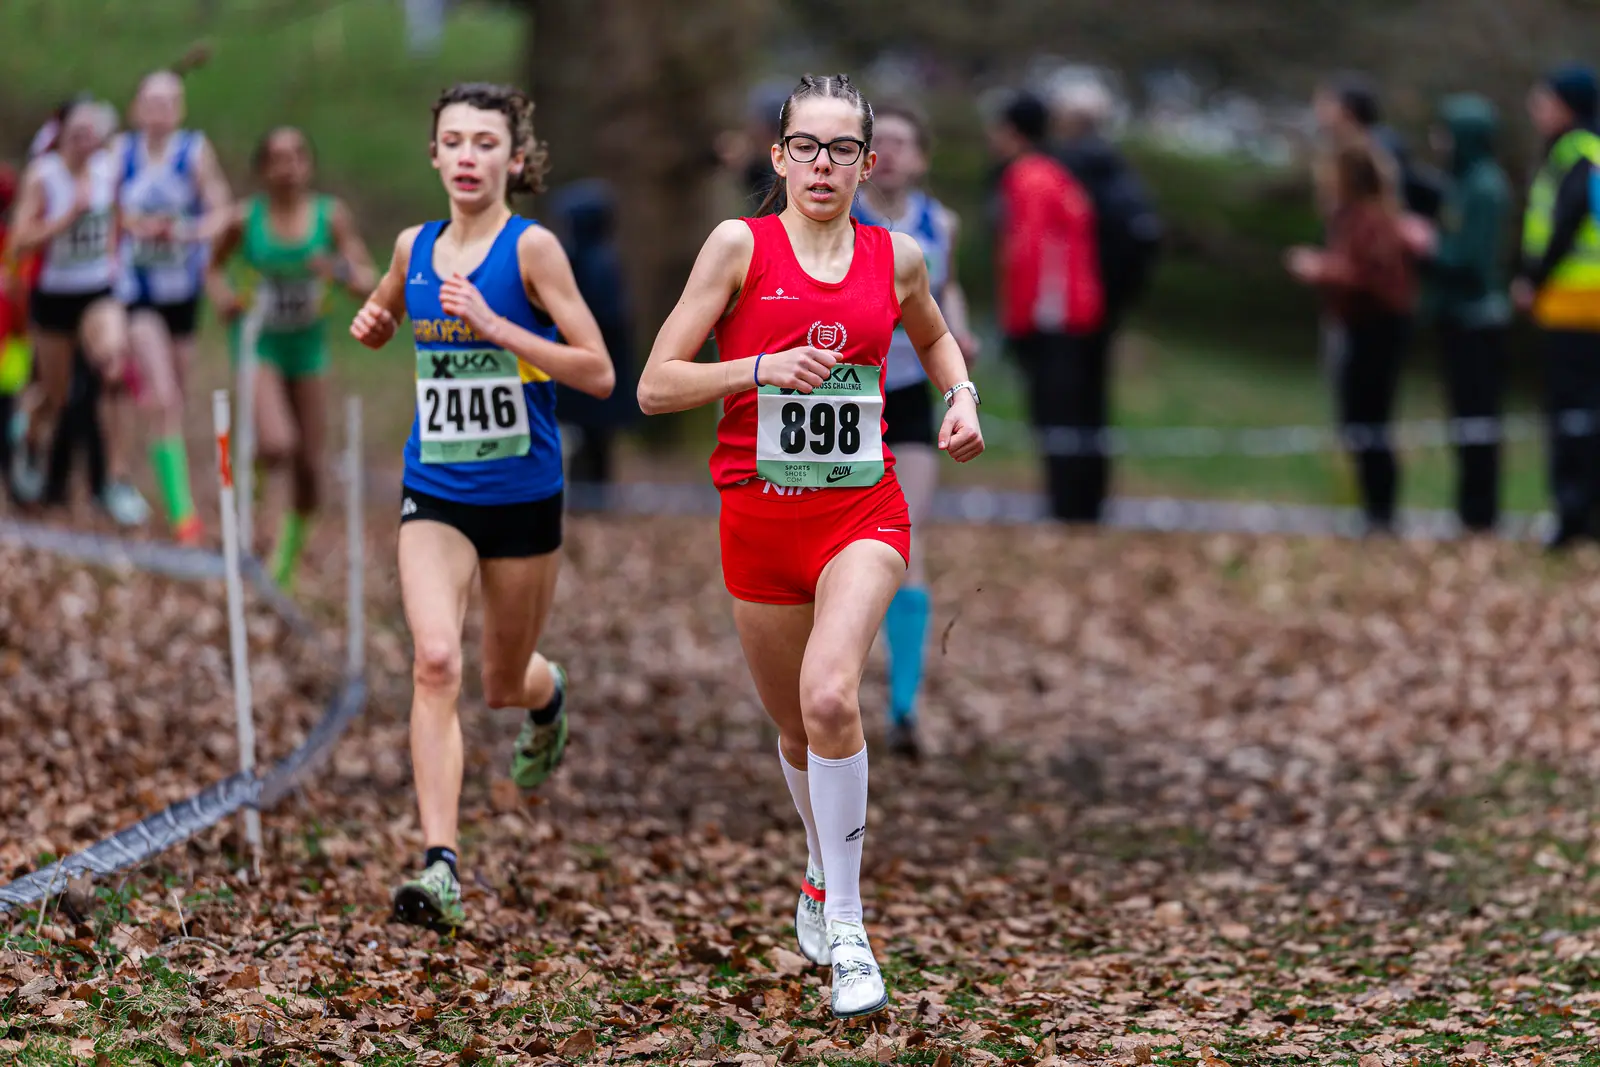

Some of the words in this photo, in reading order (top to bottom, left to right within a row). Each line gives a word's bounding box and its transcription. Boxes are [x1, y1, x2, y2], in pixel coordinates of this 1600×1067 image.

[453, 353, 500, 370] UKA
[833, 382, 862, 391] CHALLENGE
[426, 386, 516, 432] 2446
[780, 402, 860, 455] 898
[832, 465, 852, 476] RUN
